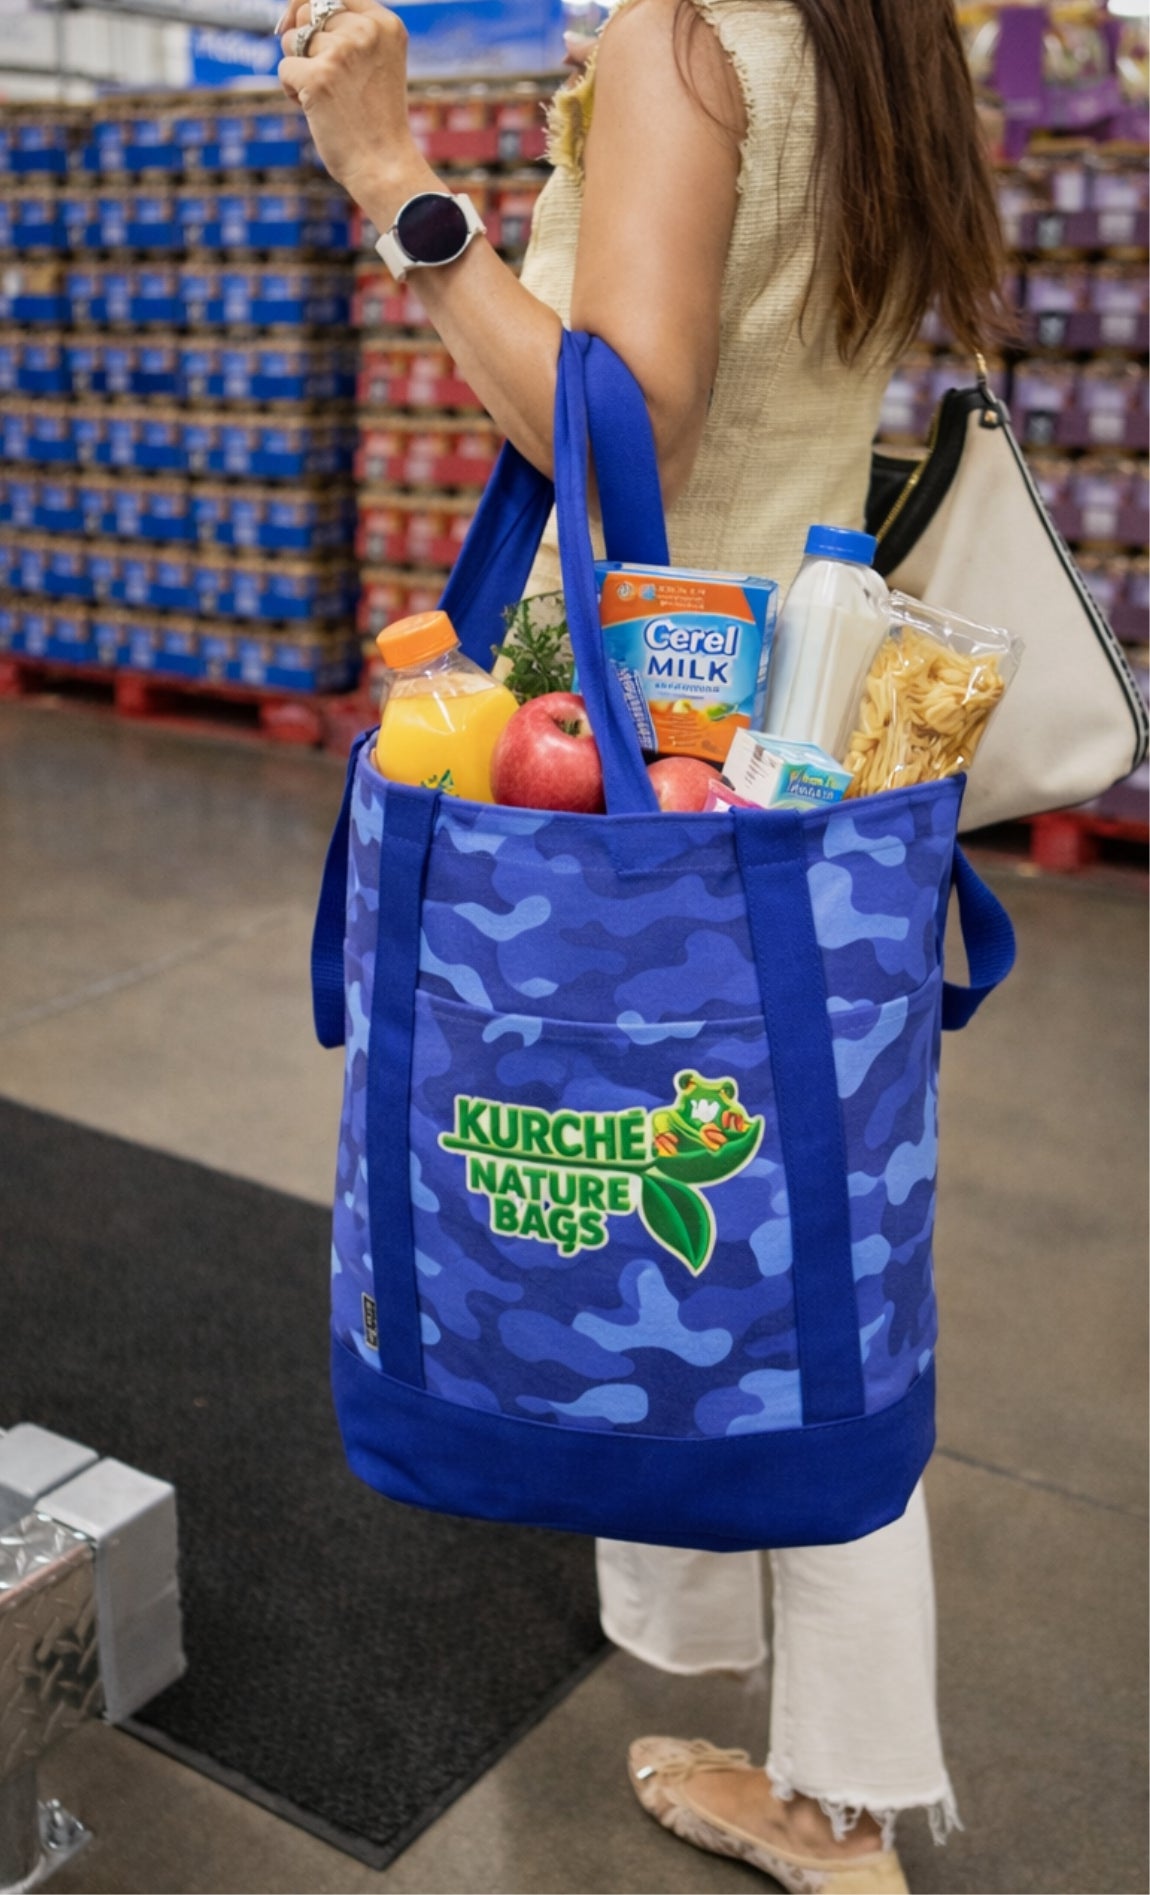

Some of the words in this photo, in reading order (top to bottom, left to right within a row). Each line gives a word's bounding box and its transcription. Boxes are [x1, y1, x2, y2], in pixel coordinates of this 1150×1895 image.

[645, 619, 738, 655] Cerel
[647, 655, 728, 684] MILK
[470, 1157, 631, 1211] NATURE
[494, 1197, 605, 1254] BAGS
